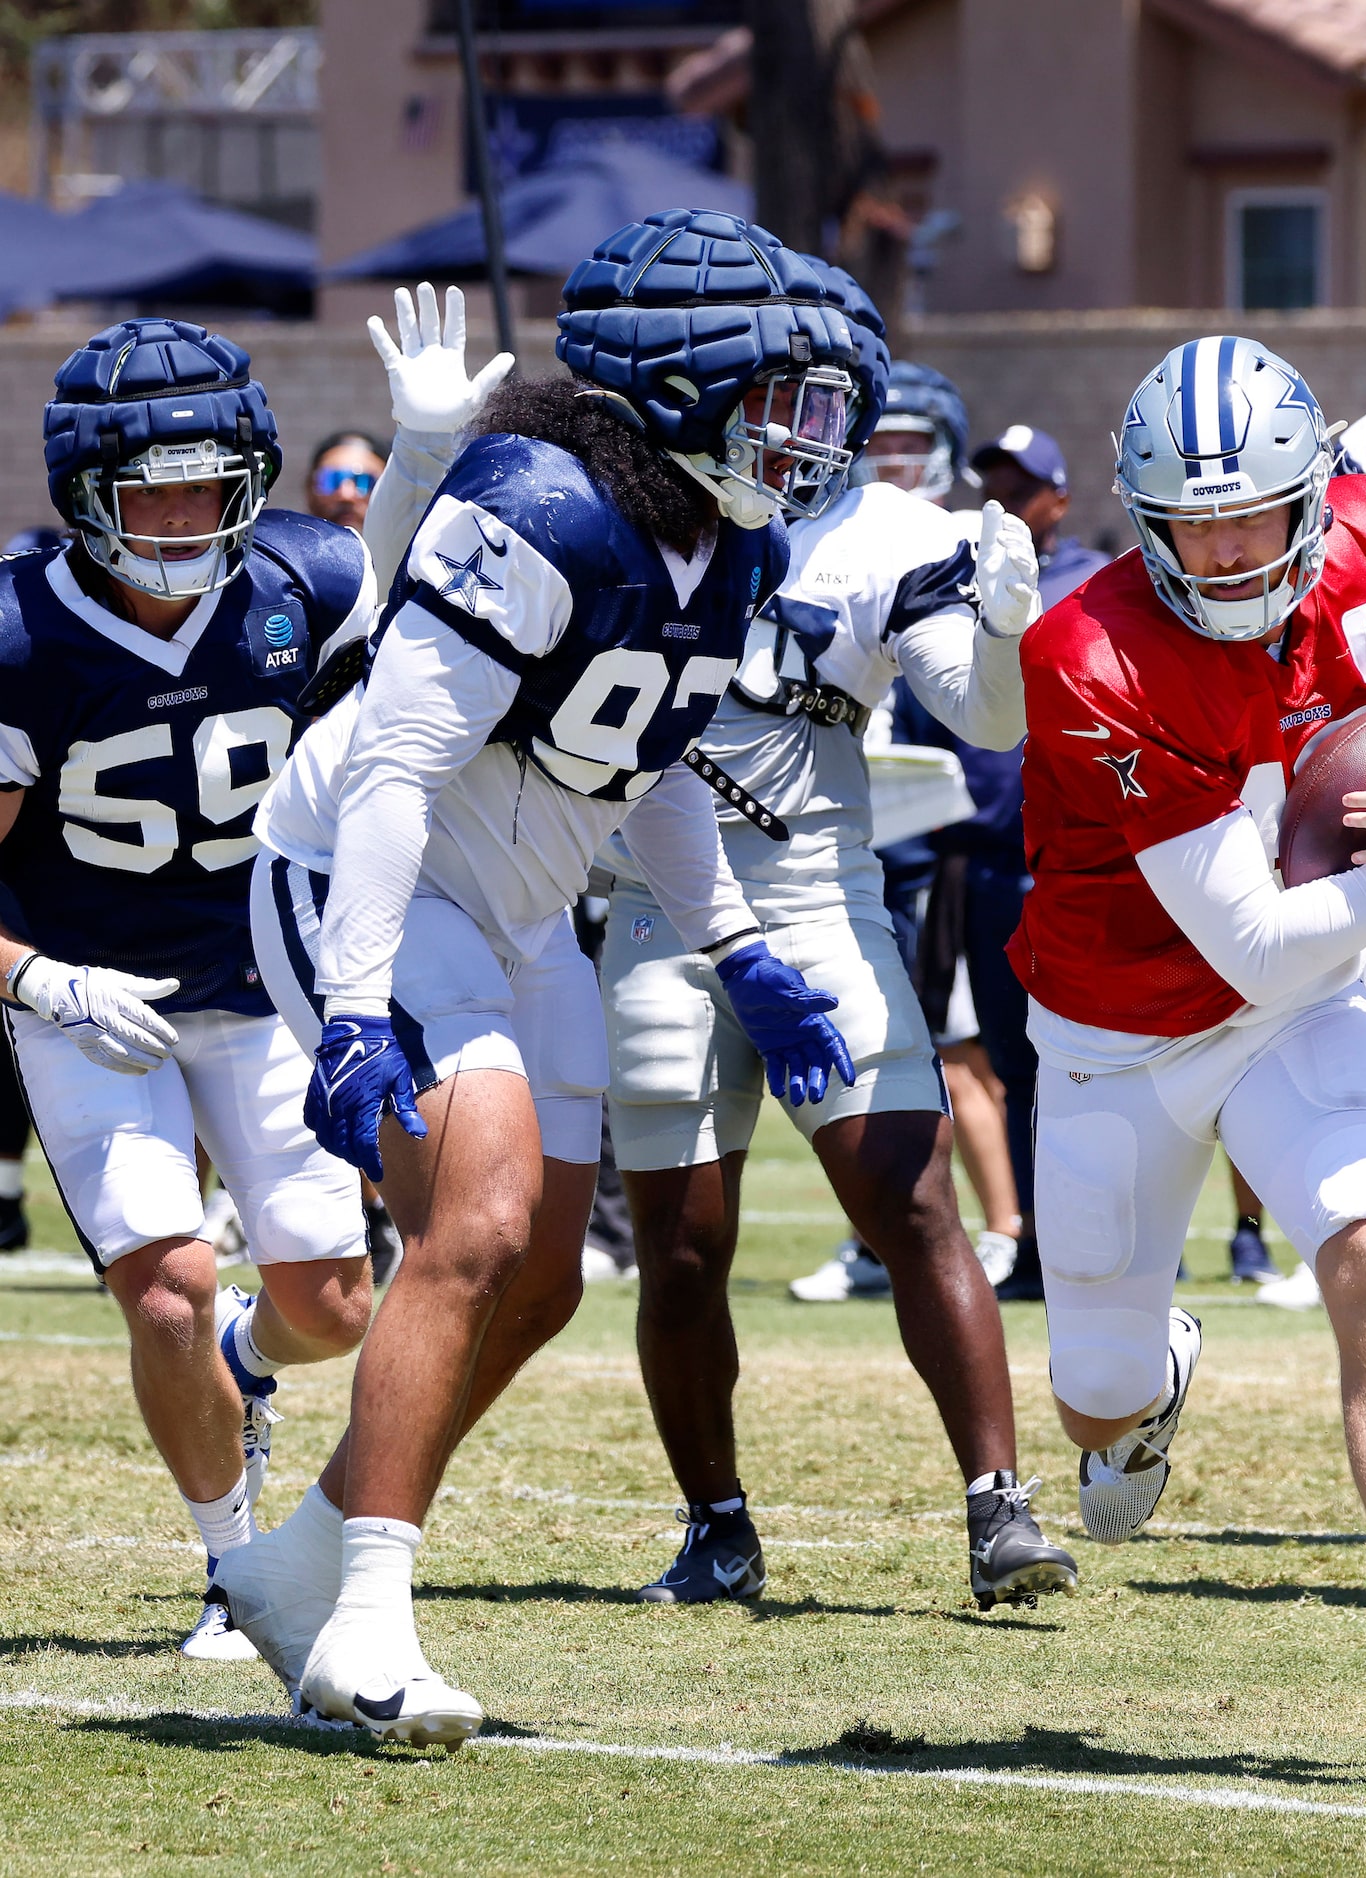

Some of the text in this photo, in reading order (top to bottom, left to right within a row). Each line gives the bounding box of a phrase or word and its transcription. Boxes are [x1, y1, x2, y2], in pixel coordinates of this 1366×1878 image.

[1192, 481, 1241, 496] COWBOYS
[814, 572, 851, 585] AT&T
[265, 647, 299, 669] AT&T
[147, 686, 208, 709] COWBOYS
[58, 706, 293, 875] 59
